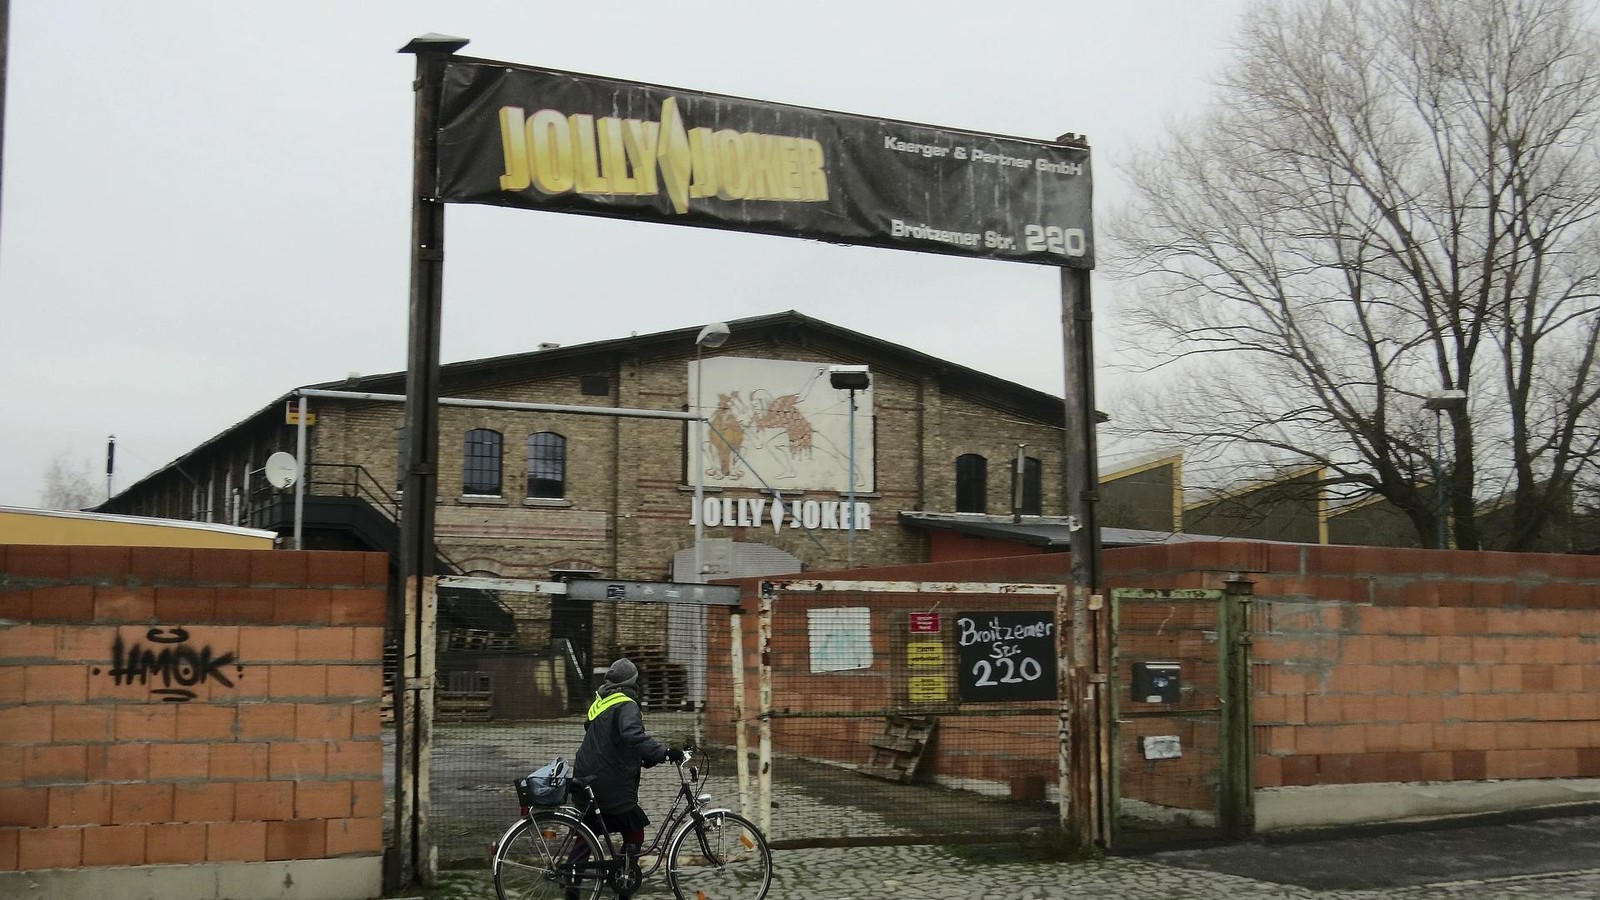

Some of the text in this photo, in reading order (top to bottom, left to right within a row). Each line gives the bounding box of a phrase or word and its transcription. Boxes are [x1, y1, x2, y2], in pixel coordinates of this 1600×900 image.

[499, 106, 829, 202] JOLLY JOKER
[884, 136, 1083, 176] Kaerger & Partner GmbH
[891, 219, 1086, 257] Broitzemer Str. 220
[789, 500, 871, 530] JOKER
[957, 617, 1054, 647] Broitzemer
[972, 657, 1042, 687] 220
